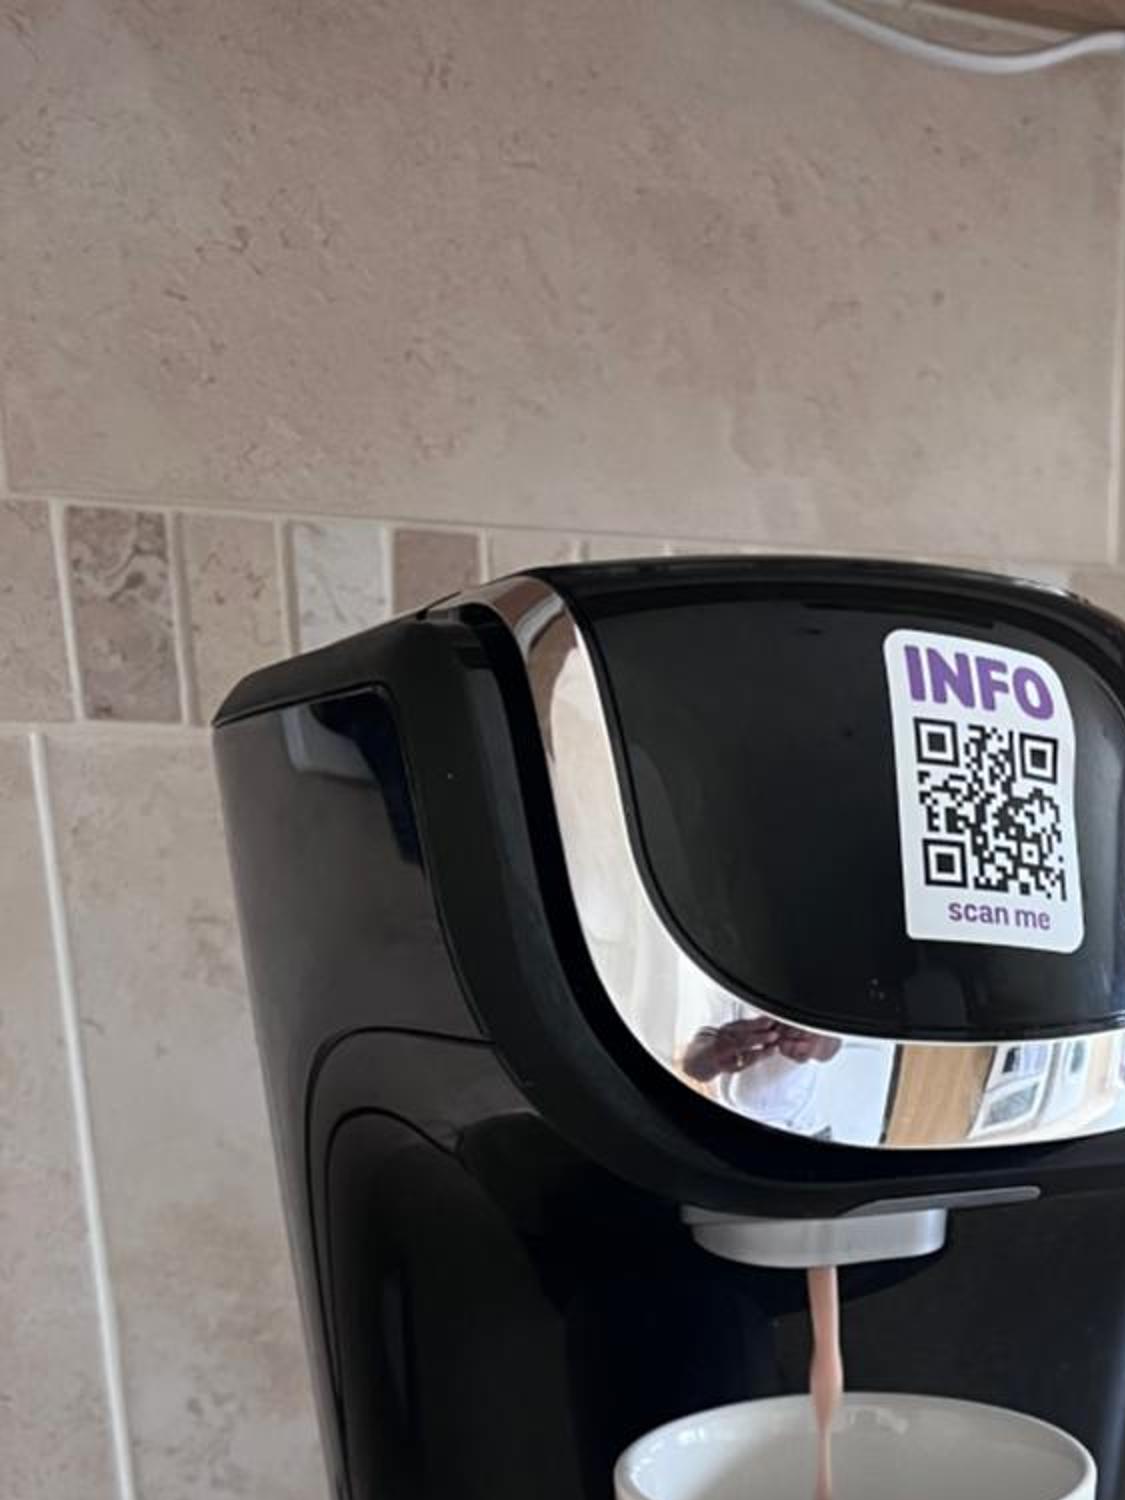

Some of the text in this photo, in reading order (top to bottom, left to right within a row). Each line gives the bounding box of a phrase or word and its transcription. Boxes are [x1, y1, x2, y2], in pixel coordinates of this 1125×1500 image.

[903, 644, 1055, 721] INFO
[948, 901, 1051, 931] scan me
